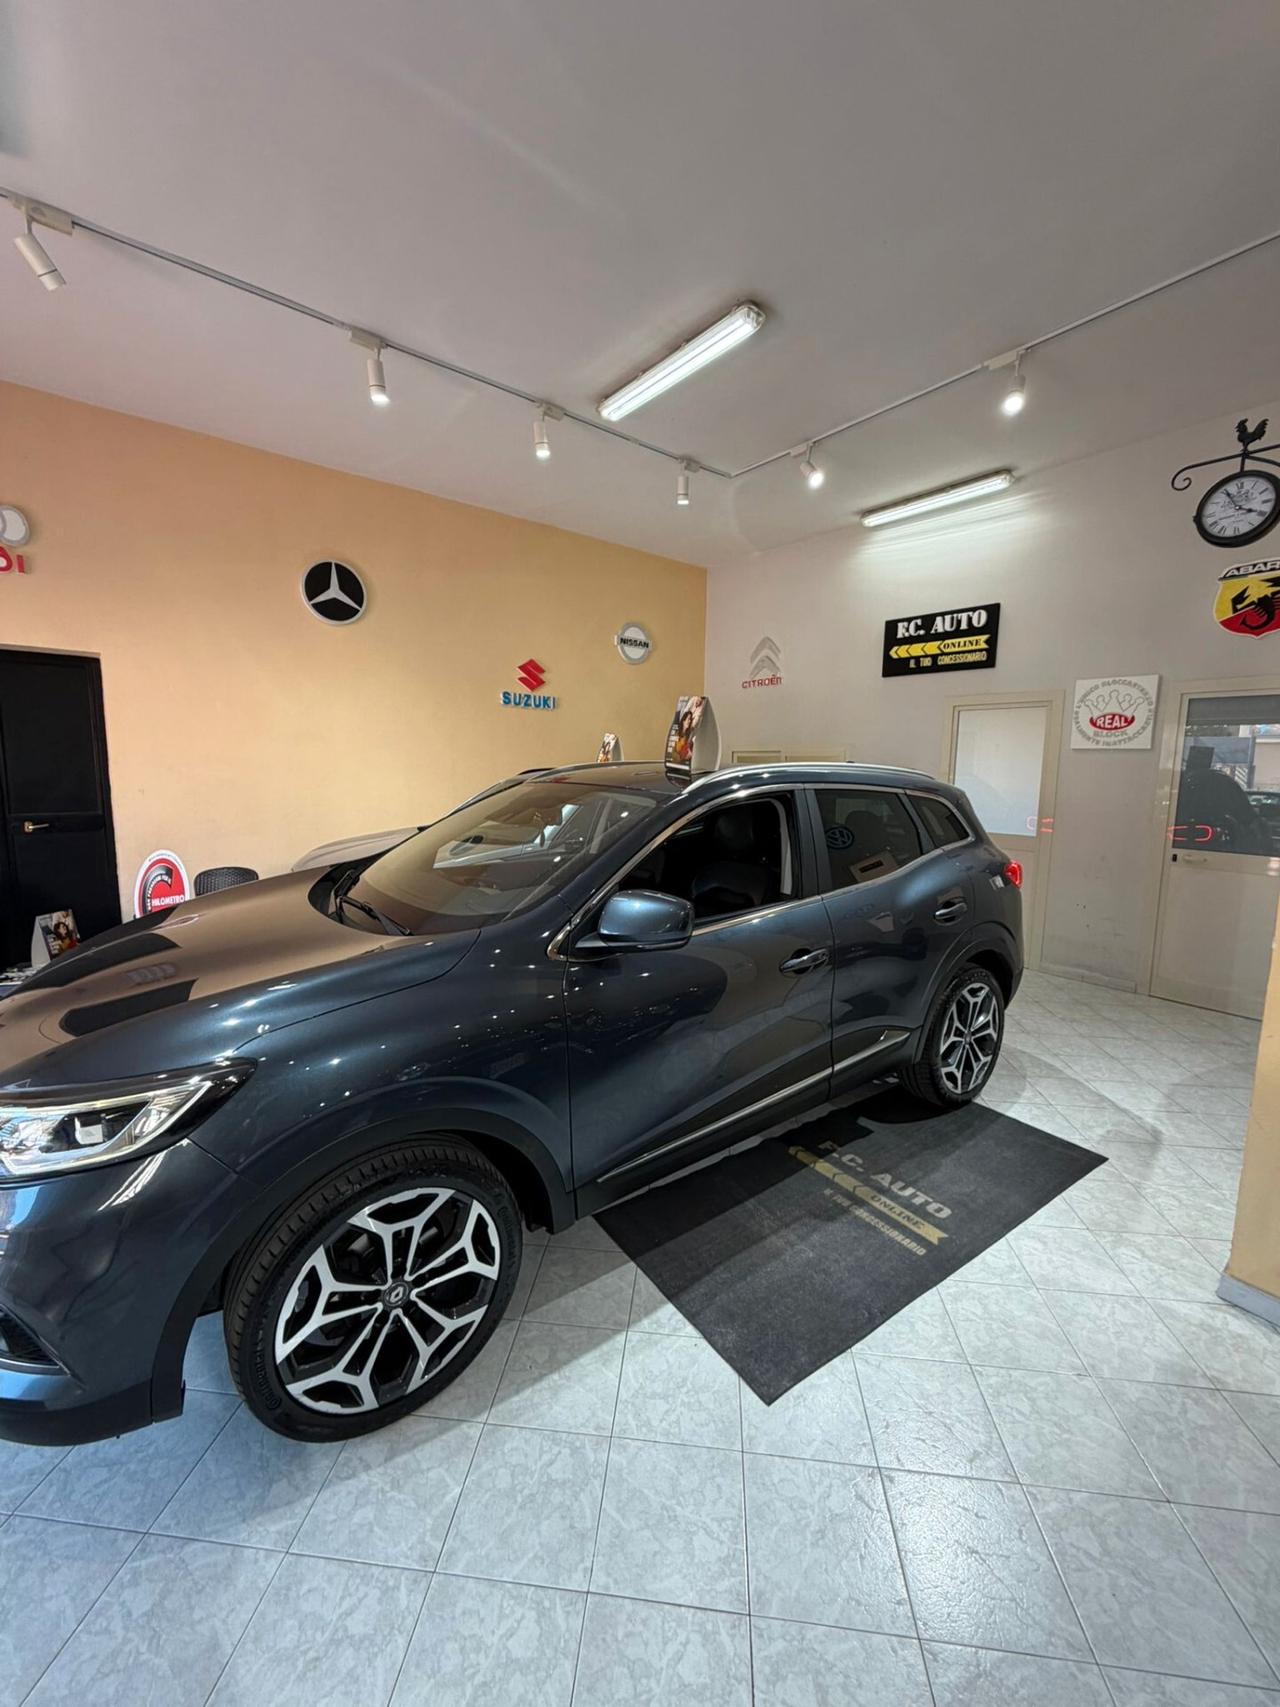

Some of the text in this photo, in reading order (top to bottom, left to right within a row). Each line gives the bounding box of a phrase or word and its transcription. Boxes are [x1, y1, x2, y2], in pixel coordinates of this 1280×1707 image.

[930, 609, 988, 633] AUTO
[620, 637, 649, 648] NISSAN
[943, 639, 981, 650] ONLINE
[938, 651, 988, 665] CONCESSIONARIO
[500, 690, 557, 709] SUZUKI
[1096, 714, 1129, 729] REAL
[870, 1173, 952, 1219] AUTO
[870, 1193, 925, 1231] ONLINE
[850, 1205, 927, 1256] CONCESSIONARIO
